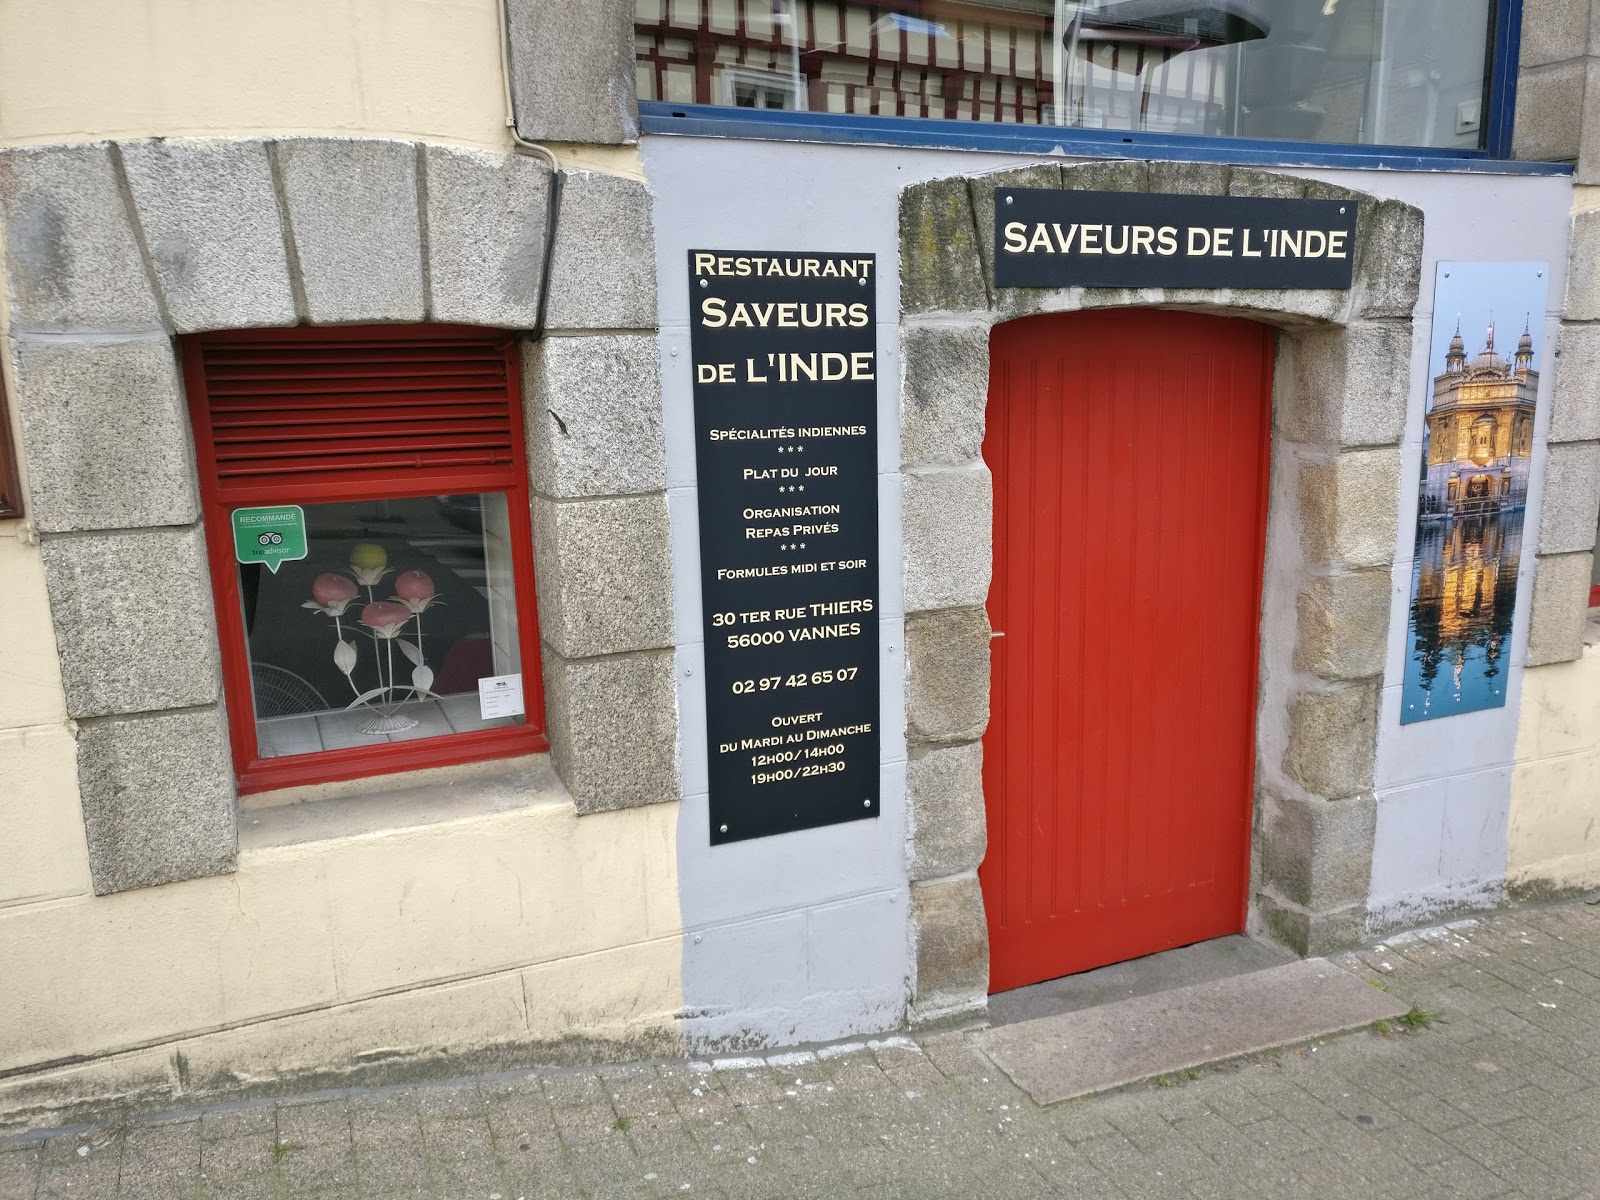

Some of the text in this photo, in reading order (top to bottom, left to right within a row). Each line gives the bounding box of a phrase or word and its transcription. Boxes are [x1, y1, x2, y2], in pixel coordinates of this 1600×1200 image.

[1003, 221, 1348, 259] SAVEURS DE L'INDE
[695, 253, 873, 278] RESTAURANT
[701, 297, 869, 328] SAVEURS
[697, 351, 875, 383] DE L'INDE
[709, 425, 867, 441] SPÉCIALITÉS INDIENNES
[743, 466, 838, 480] PLAT DU JOUR
[239, 513, 297, 524] RECOMMANDÉ
[743, 504, 840, 519] ORGANISATION
[745, 522, 839, 539] REPAS PRIVÉS
[252, 547, 290, 556] tripadvisor
[717, 559, 867, 580] FORMULES MIDI ET SOIR
[712, 598, 873, 627] 30 TER RUE THIERS
[727, 622, 861, 649] 56000 VANNES
[732, 667, 858, 695] 02 97 42 65 07
[771, 712, 823, 728] OUVERT
[719, 723, 872, 754] DU MARDI AU DIMANCHE
